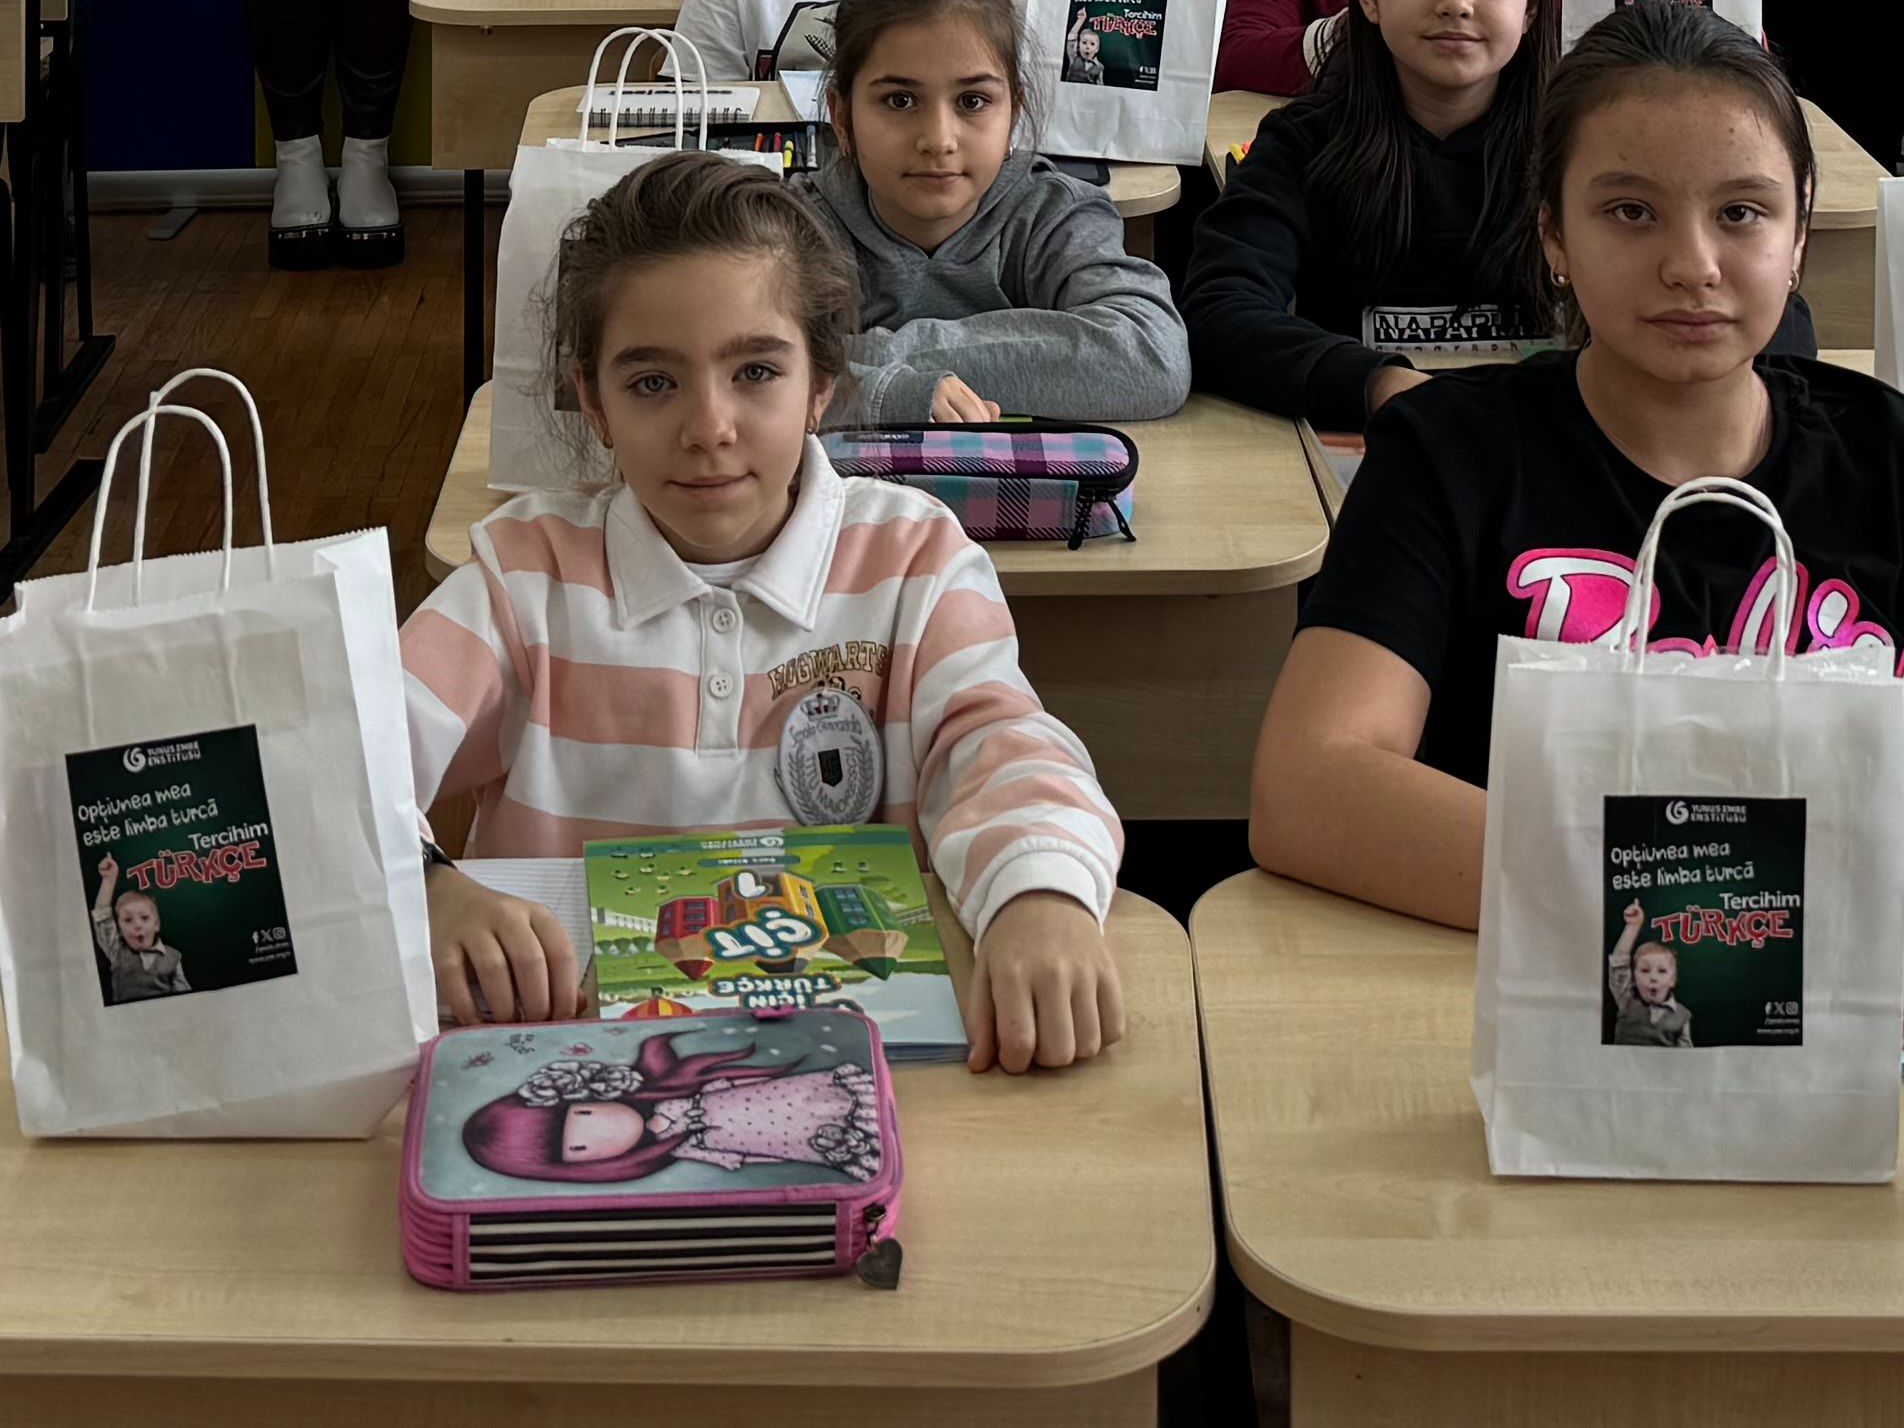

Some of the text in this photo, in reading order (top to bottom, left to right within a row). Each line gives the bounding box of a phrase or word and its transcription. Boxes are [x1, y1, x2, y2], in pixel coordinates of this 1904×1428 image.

[767, 640, 890, 700] HOGWARTS
[77, 783, 192, 824] Opțiunea mea
[83, 798, 219, 846] este limba turcă
[188, 822, 268, 850] Tercihim
[126, 840, 267, 890] TÜRKÇE
[1611, 842, 1731, 870] Opțiunea mea
[737, 872, 766, 898] 1
[1613, 861, 1755, 890] este limba turcă
[1719, 891, 1801, 909] Tercihim
[714, 909, 813, 959] ÇİT
[1651, 905, 1794, 948] TÜRKÇE
[717, 976, 833, 995] TÜRKÇE
